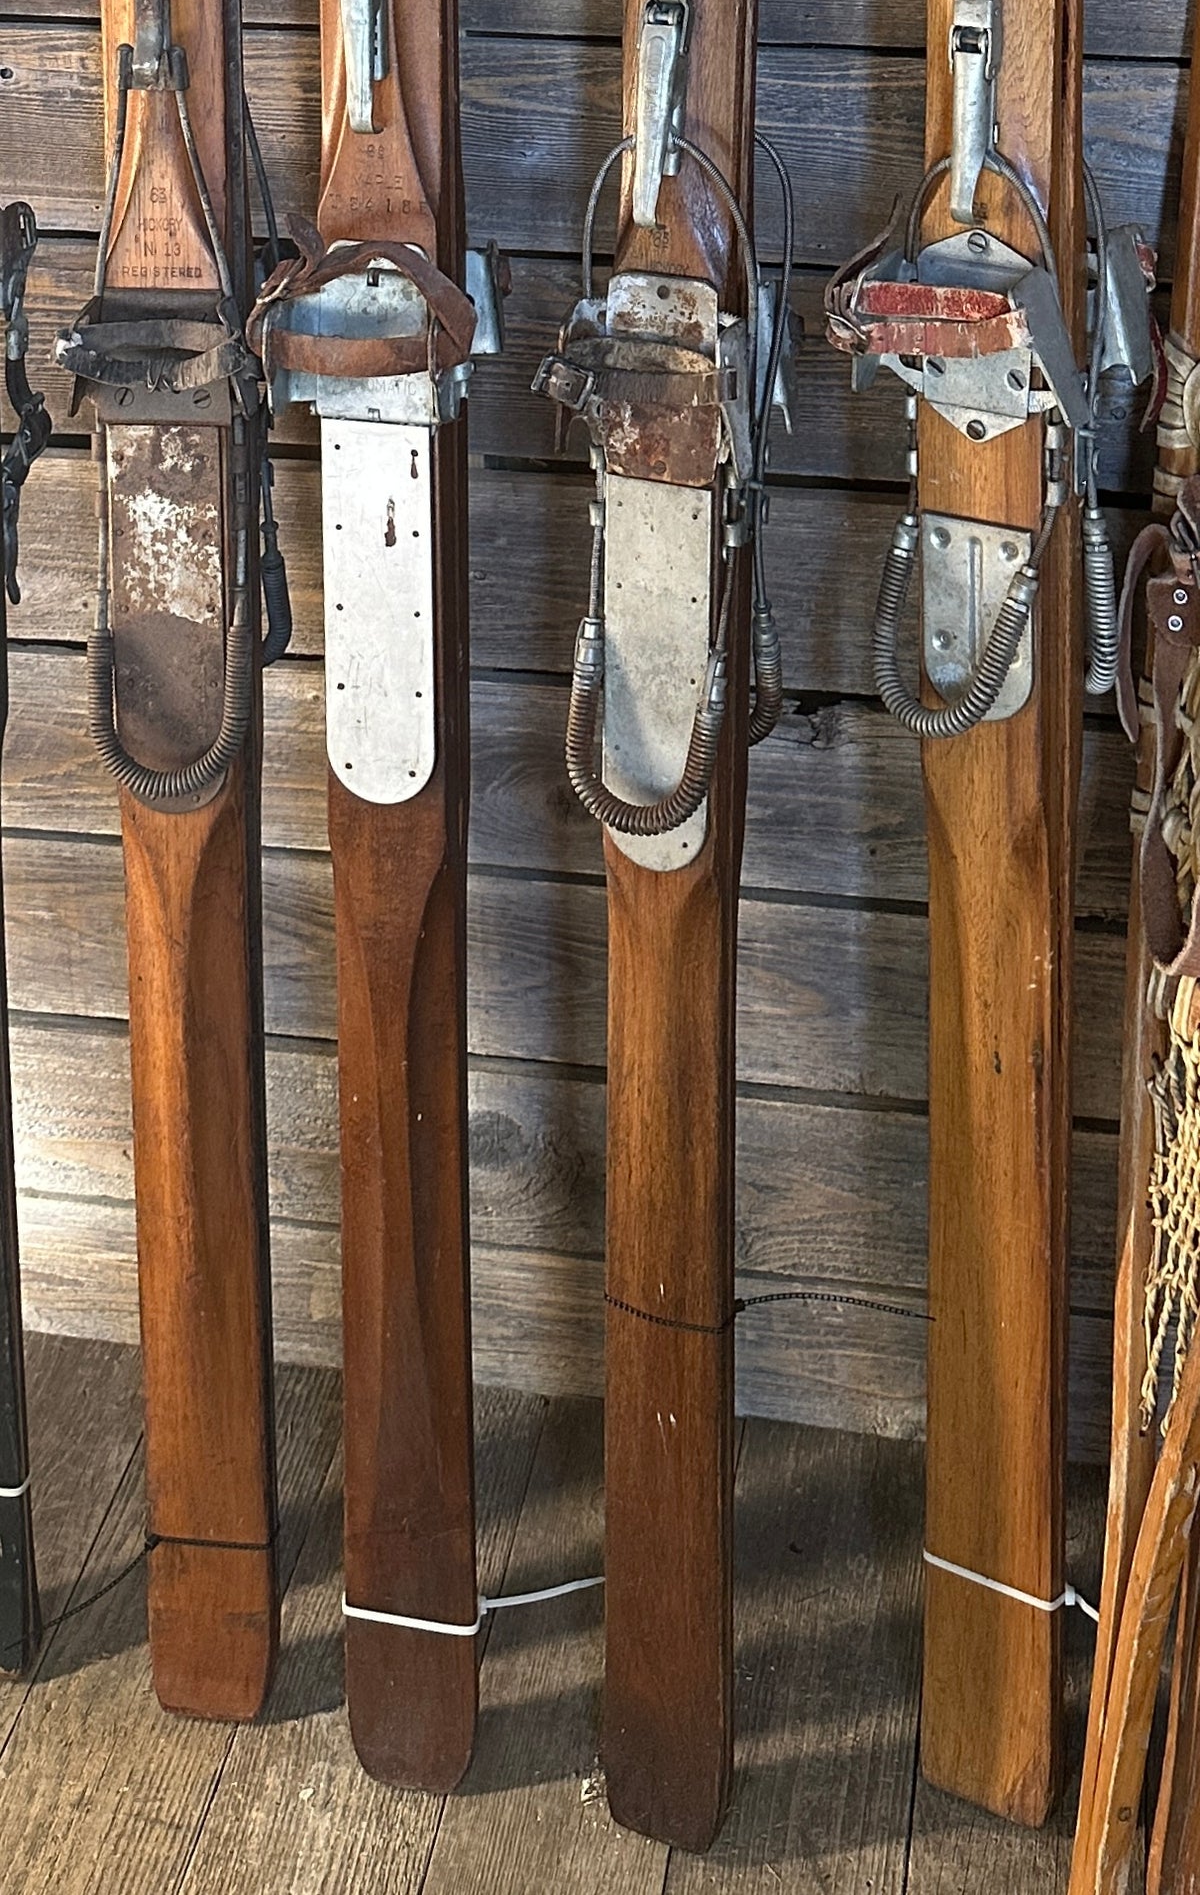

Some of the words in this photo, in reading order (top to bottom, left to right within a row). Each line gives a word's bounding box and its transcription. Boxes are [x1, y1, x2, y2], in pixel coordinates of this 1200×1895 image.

[138, 217, 183, 232] HICKORY
[164, 241, 181, 257] 13
[122, 265, 203, 278] REGISTERED
